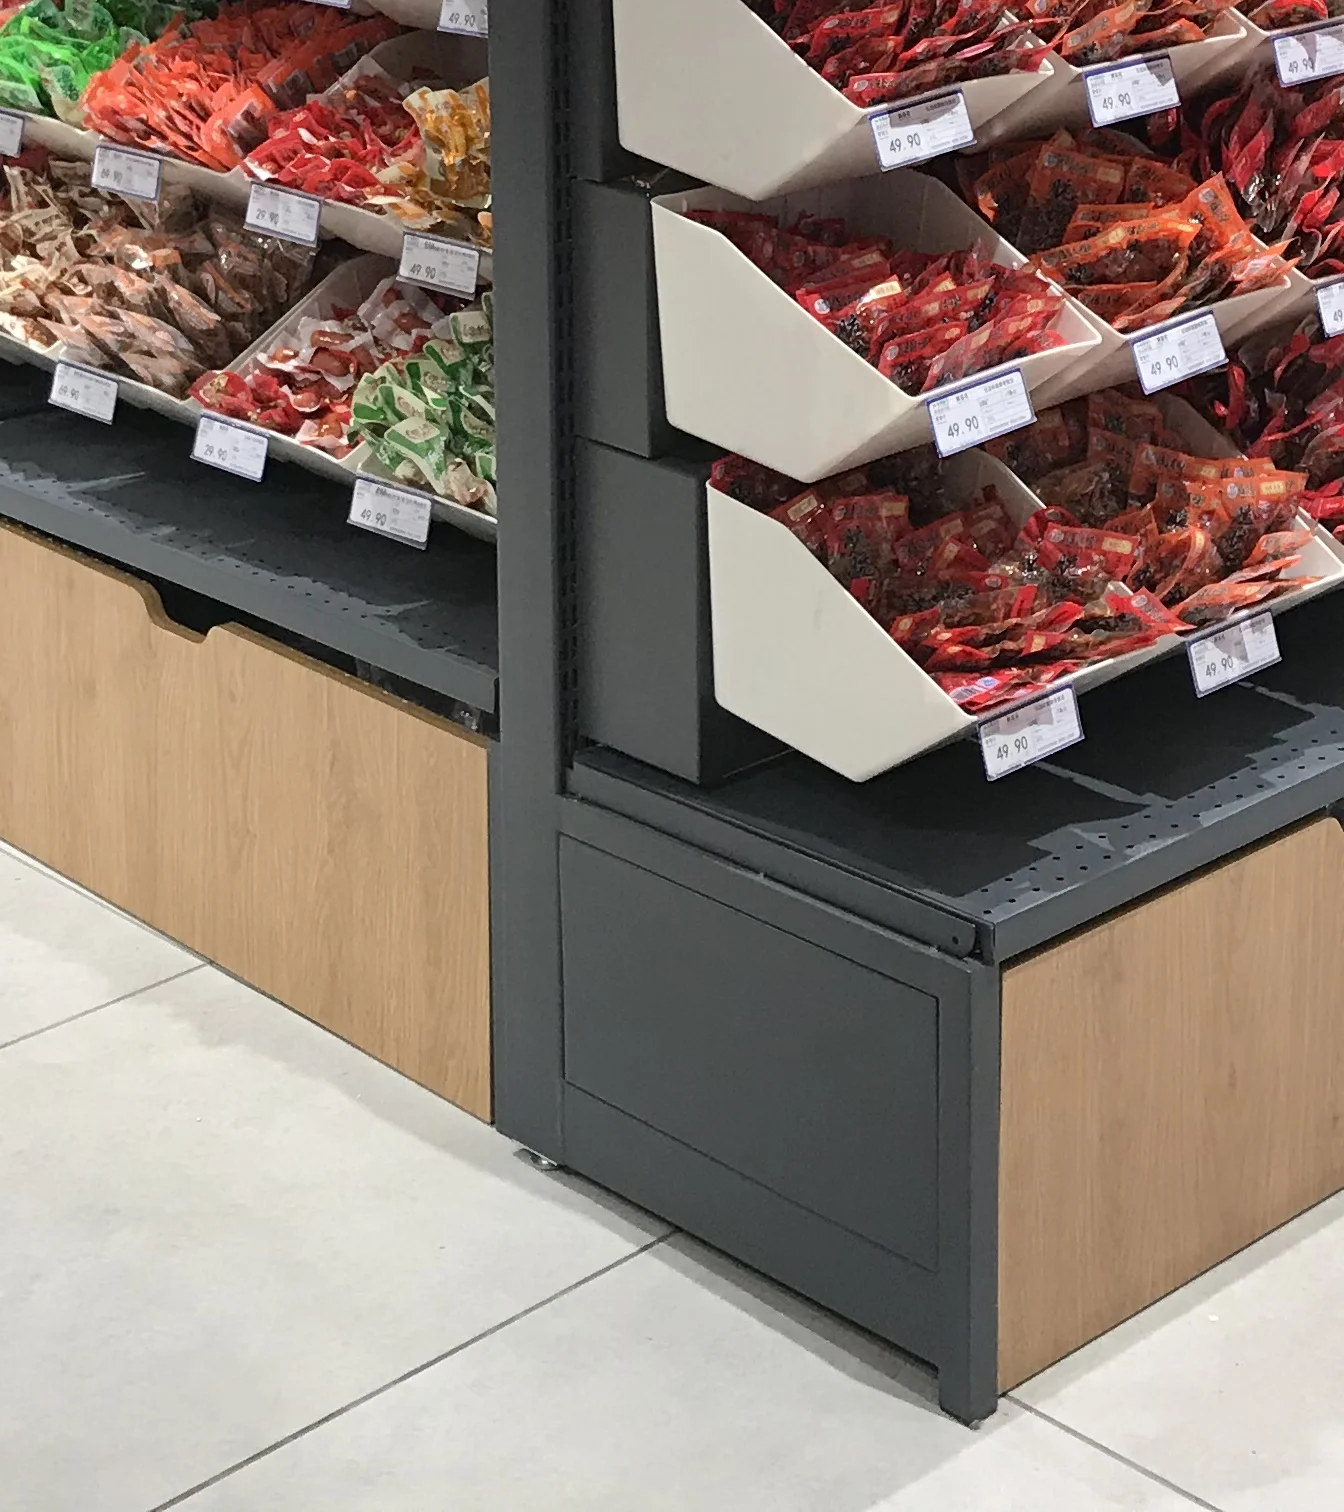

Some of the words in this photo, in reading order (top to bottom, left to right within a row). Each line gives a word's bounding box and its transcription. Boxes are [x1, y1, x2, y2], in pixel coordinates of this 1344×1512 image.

[449, 12, 476, 27] 49.90
[1102, 92, 1131, 110] 49.90
[889, 133, 921, 153] 49.90
[1150, 354, 1179, 376] 49.90
[947, 415, 979, 438] 49.90
[360, 508, 387, 527] 49.90
[1205, 655, 1234, 678] 49.90
[996, 736, 1028, 760] 49.90
